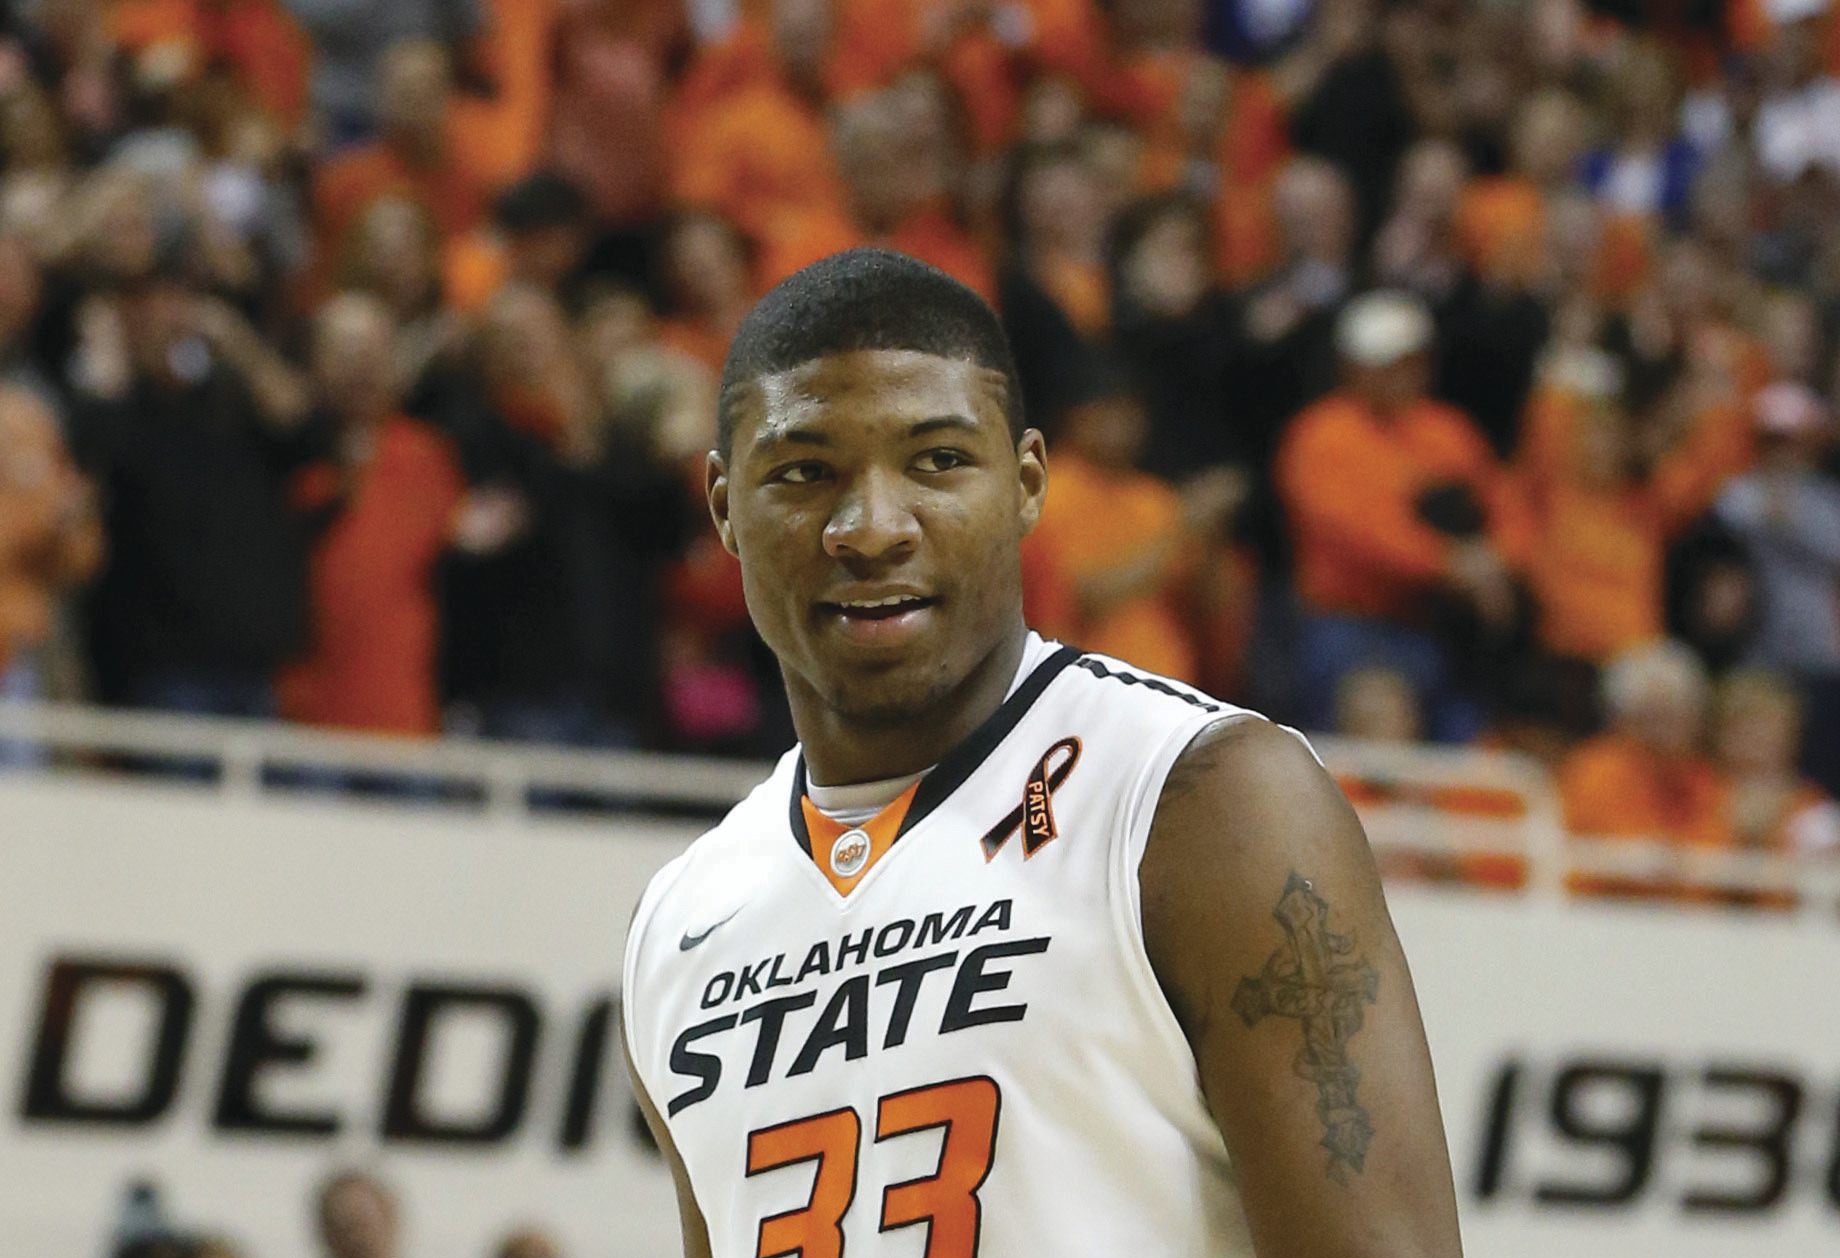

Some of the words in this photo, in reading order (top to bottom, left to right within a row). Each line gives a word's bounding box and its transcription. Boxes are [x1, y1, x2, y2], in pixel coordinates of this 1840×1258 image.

[1028, 780, 1050, 837] PATSY
[668, 937, 1051, 1120] STATE
[700, 898, 1013, 1011] OKLAHOMA
[20, 953, 662, 1160] DEDI
[1472, 1053, 1840, 1219] 193
